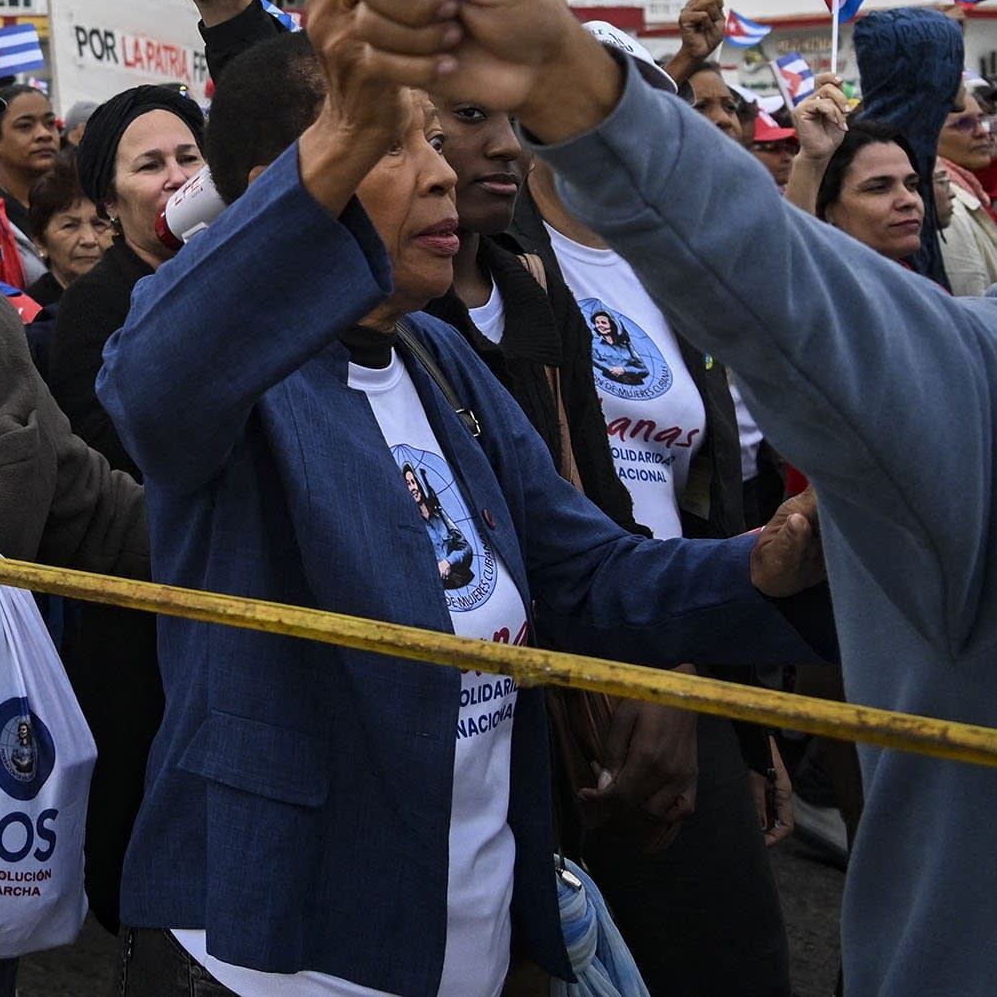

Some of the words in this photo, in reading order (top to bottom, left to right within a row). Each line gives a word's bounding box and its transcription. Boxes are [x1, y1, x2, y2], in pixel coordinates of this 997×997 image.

[75, 25, 118, 64] POR
[605, 382, 618, 393] DE
[618, 387, 655, 399] MUJERES
[446, 596, 457, 608] DE
[457, 580, 491, 608] MUJERES
